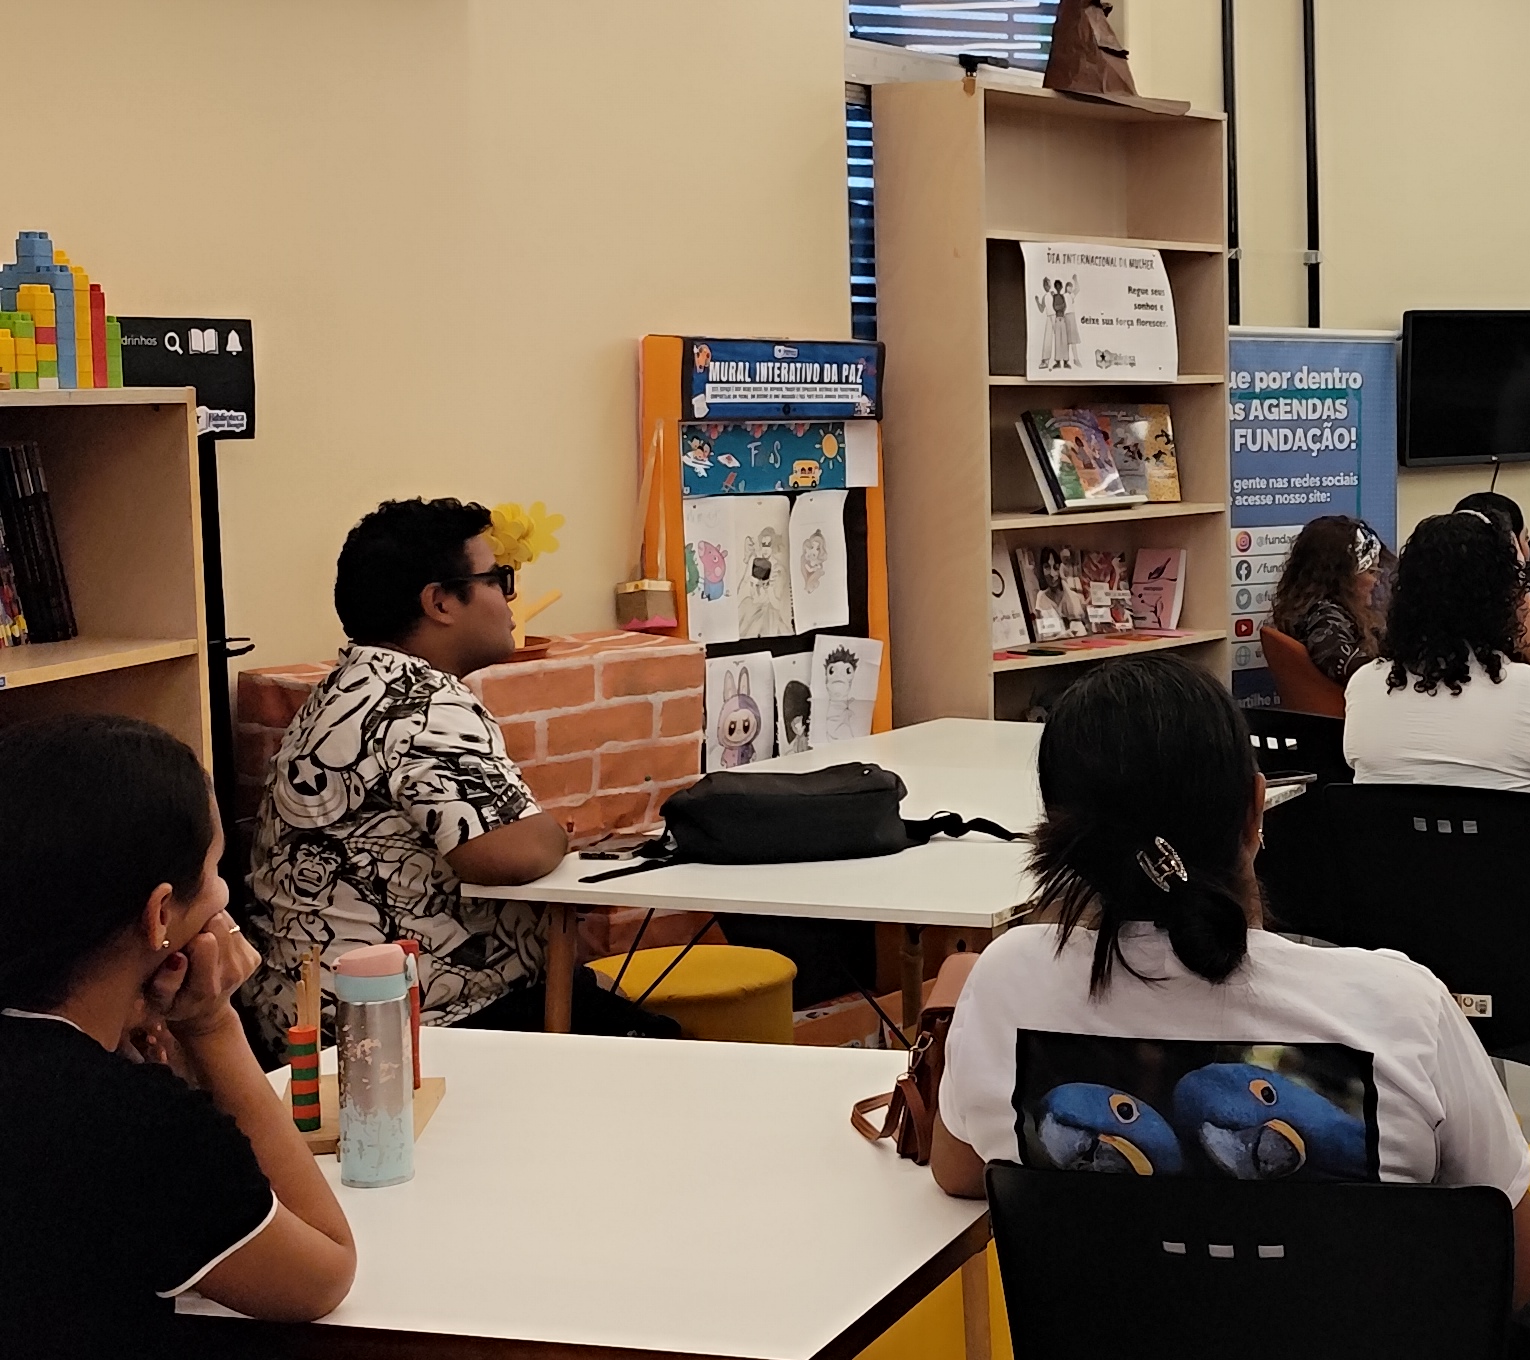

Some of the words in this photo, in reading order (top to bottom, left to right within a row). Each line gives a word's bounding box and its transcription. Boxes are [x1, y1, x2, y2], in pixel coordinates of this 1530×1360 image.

[1046, 252, 1061, 265] DIA
[1062, 253, 1118, 268] INTERNACIONAL
[1128, 258, 1155, 271] MULHER
[1127, 285, 1149, 298] Regue
[1150, 288, 1165, 297] seus
[1133, 302, 1158, 312] sonhos
[1080, 315, 1100, 325] deixe
[1101, 317, 1114, 326] sua
[1115, 316, 1135, 329] força
[708, 361, 752, 383] MURAL
[755, 361, 820, 383] INTERATIVO
[823, 362, 839, 383] DA
[841, 363, 864, 383] PAZ
[1254, 370, 1292, 393] por
[1293, 365, 1363, 390] dentro
[1248, 397, 1348, 421] AGENDAS
[1234, 421, 1357, 457] FUNDAÇÃO!
[1233, 476, 1267, 493] gente
[1268, 477, 1289, 489] nas
[1290, 473, 1321, 488] redes
[1321, 472, 1359, 487] sociais
[1234, 493, 1274, 506] acesse
[1274, 492, 1307, 505] nosso
[1308, 489, 1331, 503] site:
